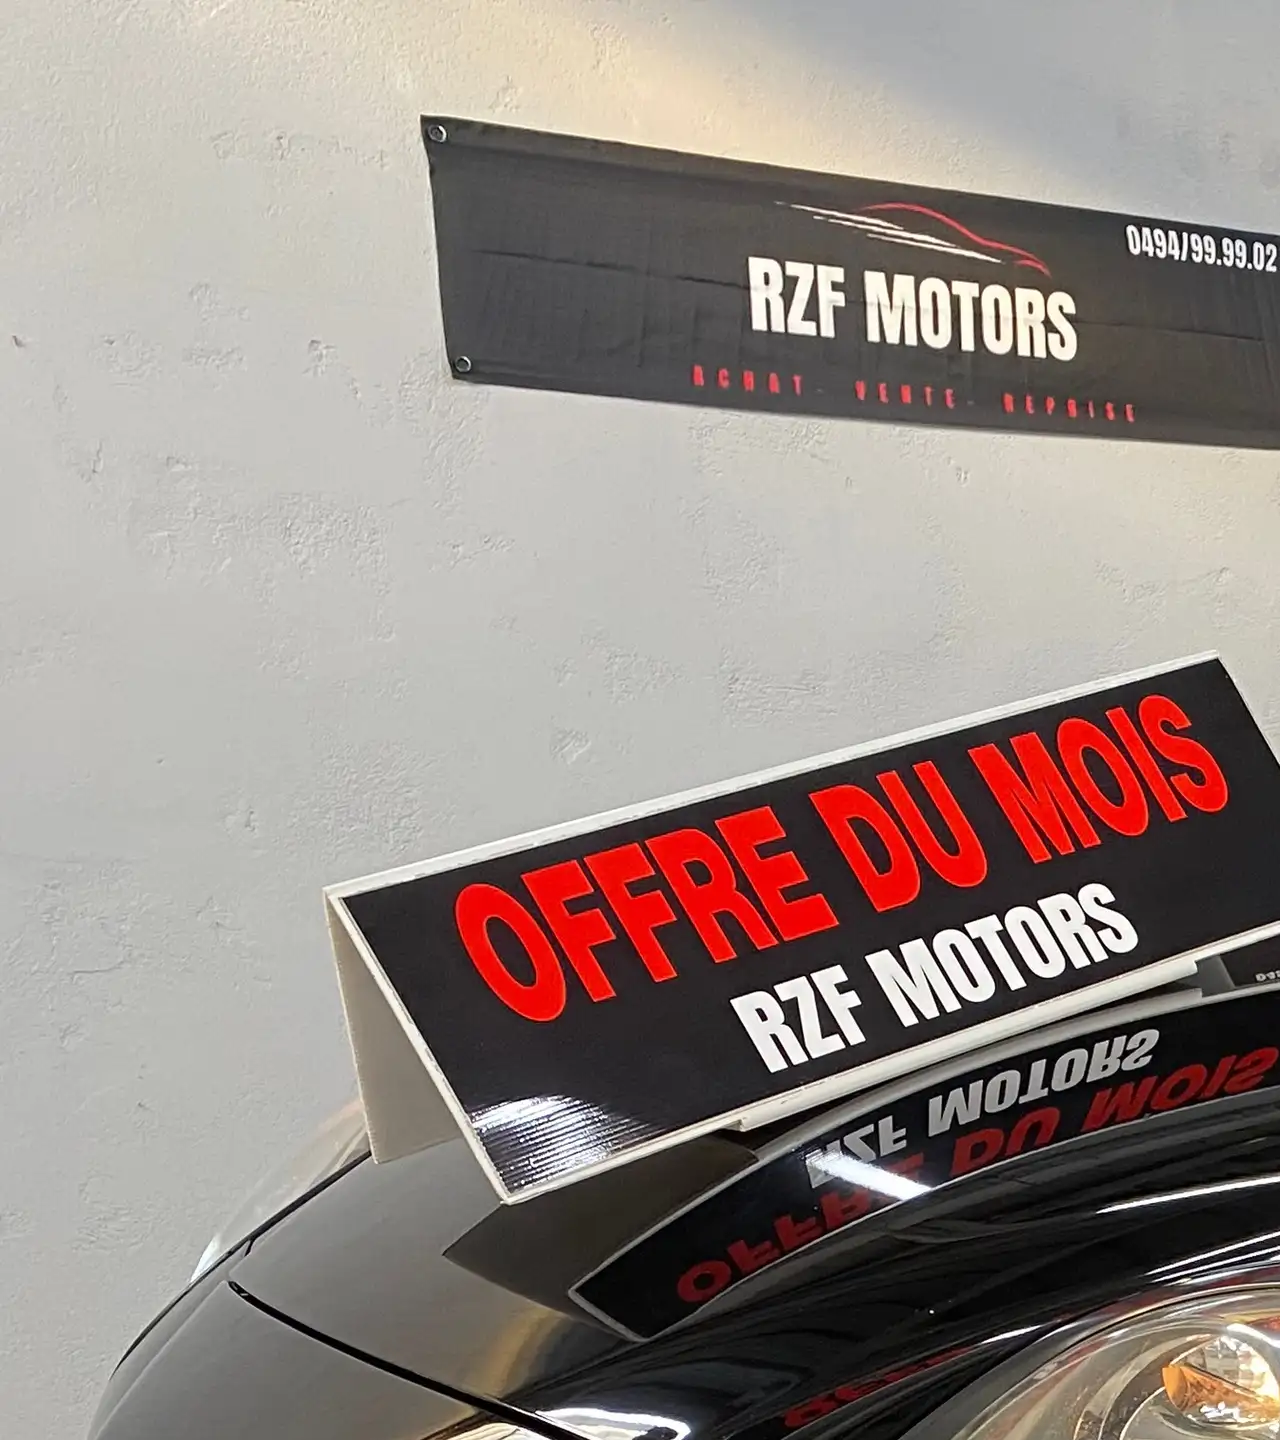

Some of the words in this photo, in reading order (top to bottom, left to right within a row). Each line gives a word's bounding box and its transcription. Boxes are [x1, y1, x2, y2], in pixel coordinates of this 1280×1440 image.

[748, 256, 847, 338] RZF
[864, 271, 1078, 361] MOTORS
[1125, 224, 1279, 272] 0494/99.99.02
[454, 806, 843, 1023] OFFRE
[810, 759, 990, 913] DU
[968, 693, 1229, 866] MOIS
[730, 965, 862, 1074] RZF
[876, 882, 1139, 1029] MOTORS
